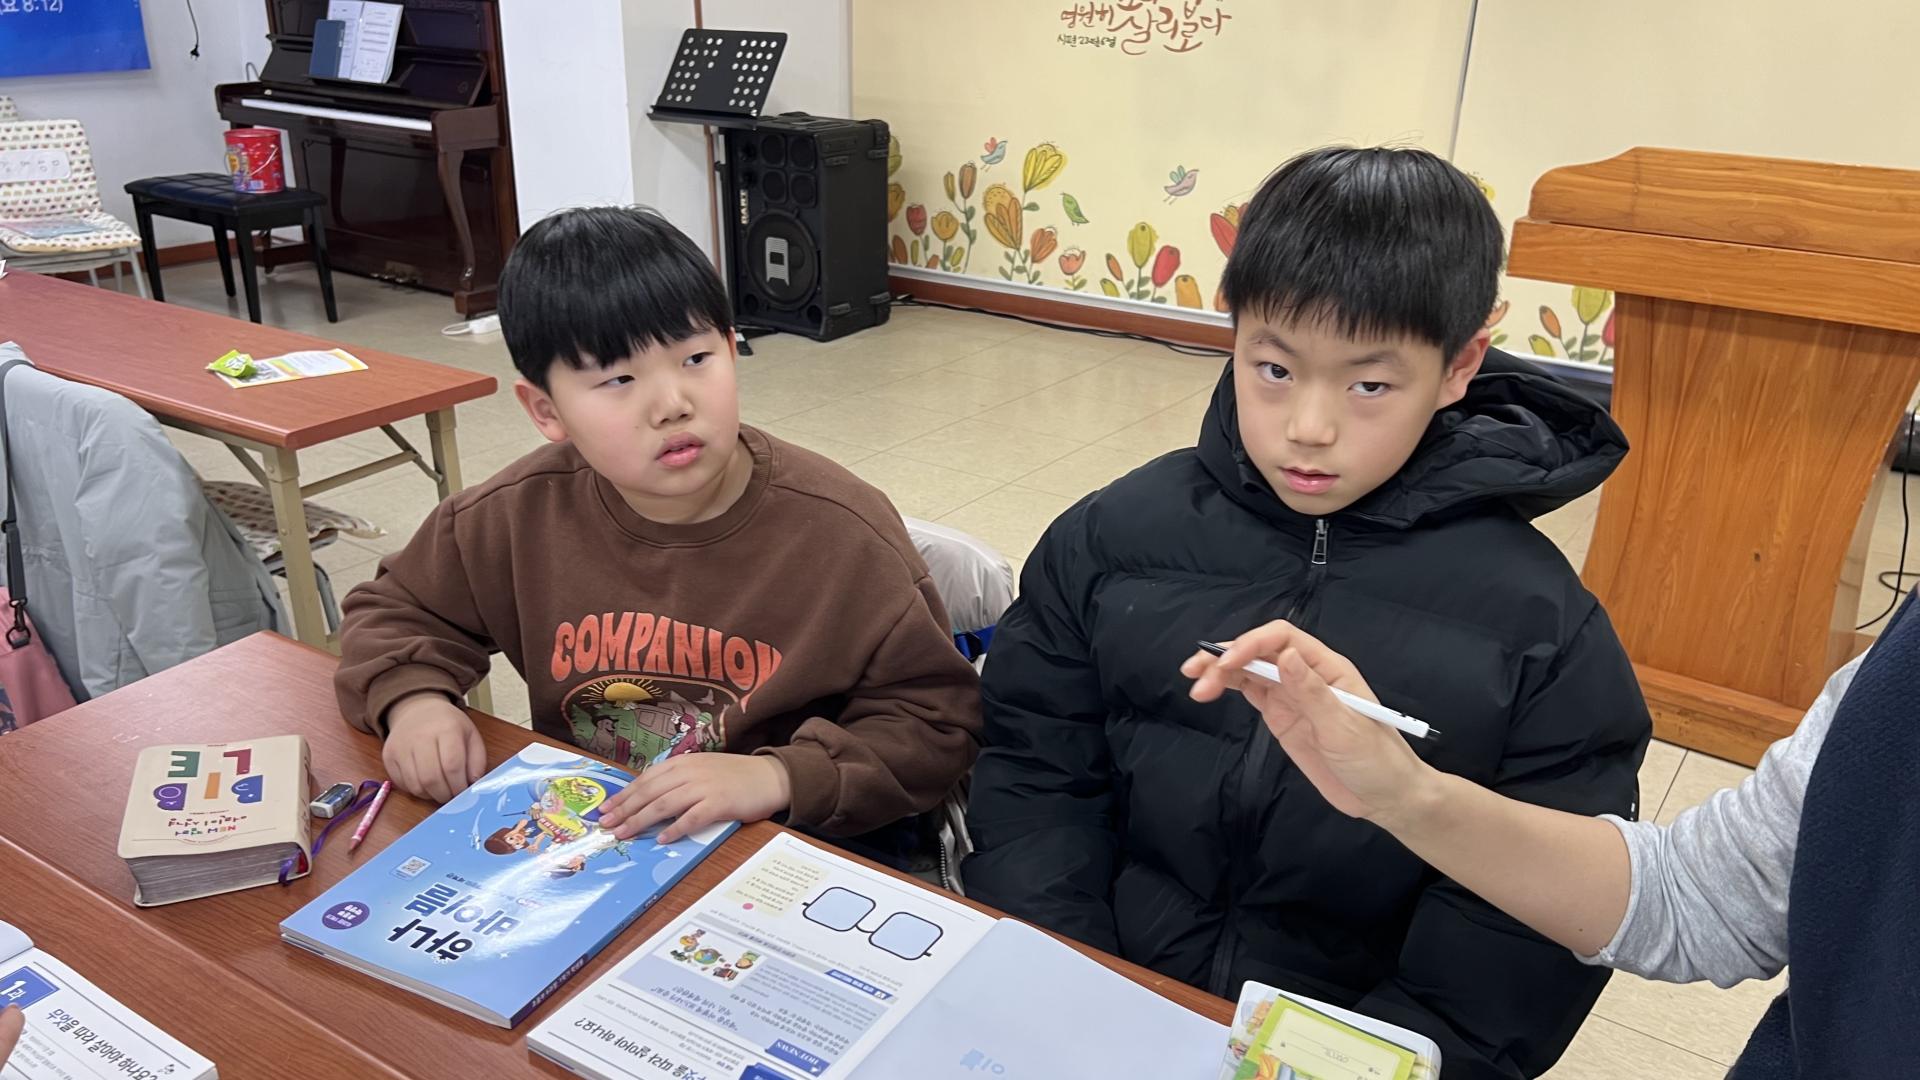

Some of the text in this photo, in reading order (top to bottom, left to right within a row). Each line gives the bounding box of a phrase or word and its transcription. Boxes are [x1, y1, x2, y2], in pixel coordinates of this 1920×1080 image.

[168, 817, 200, 827] 성경
[207, 824, 237, 834] NEW
[404, 883, 521, 936] 바이블
[387, 918, 473, 961] 하나
[46, 1008, 80, 1033] 무엇을
[73, 1026, 95, 1045] 따라
[87, 1038, 121, 1067] 살아야
[573, 1017, 616, 1043] 하나요?
[613, 1036, 652, 1059] 살아야
[774, 1041, 802, 1057] NEWS
[648, 1053, 675, 1072] 따라
